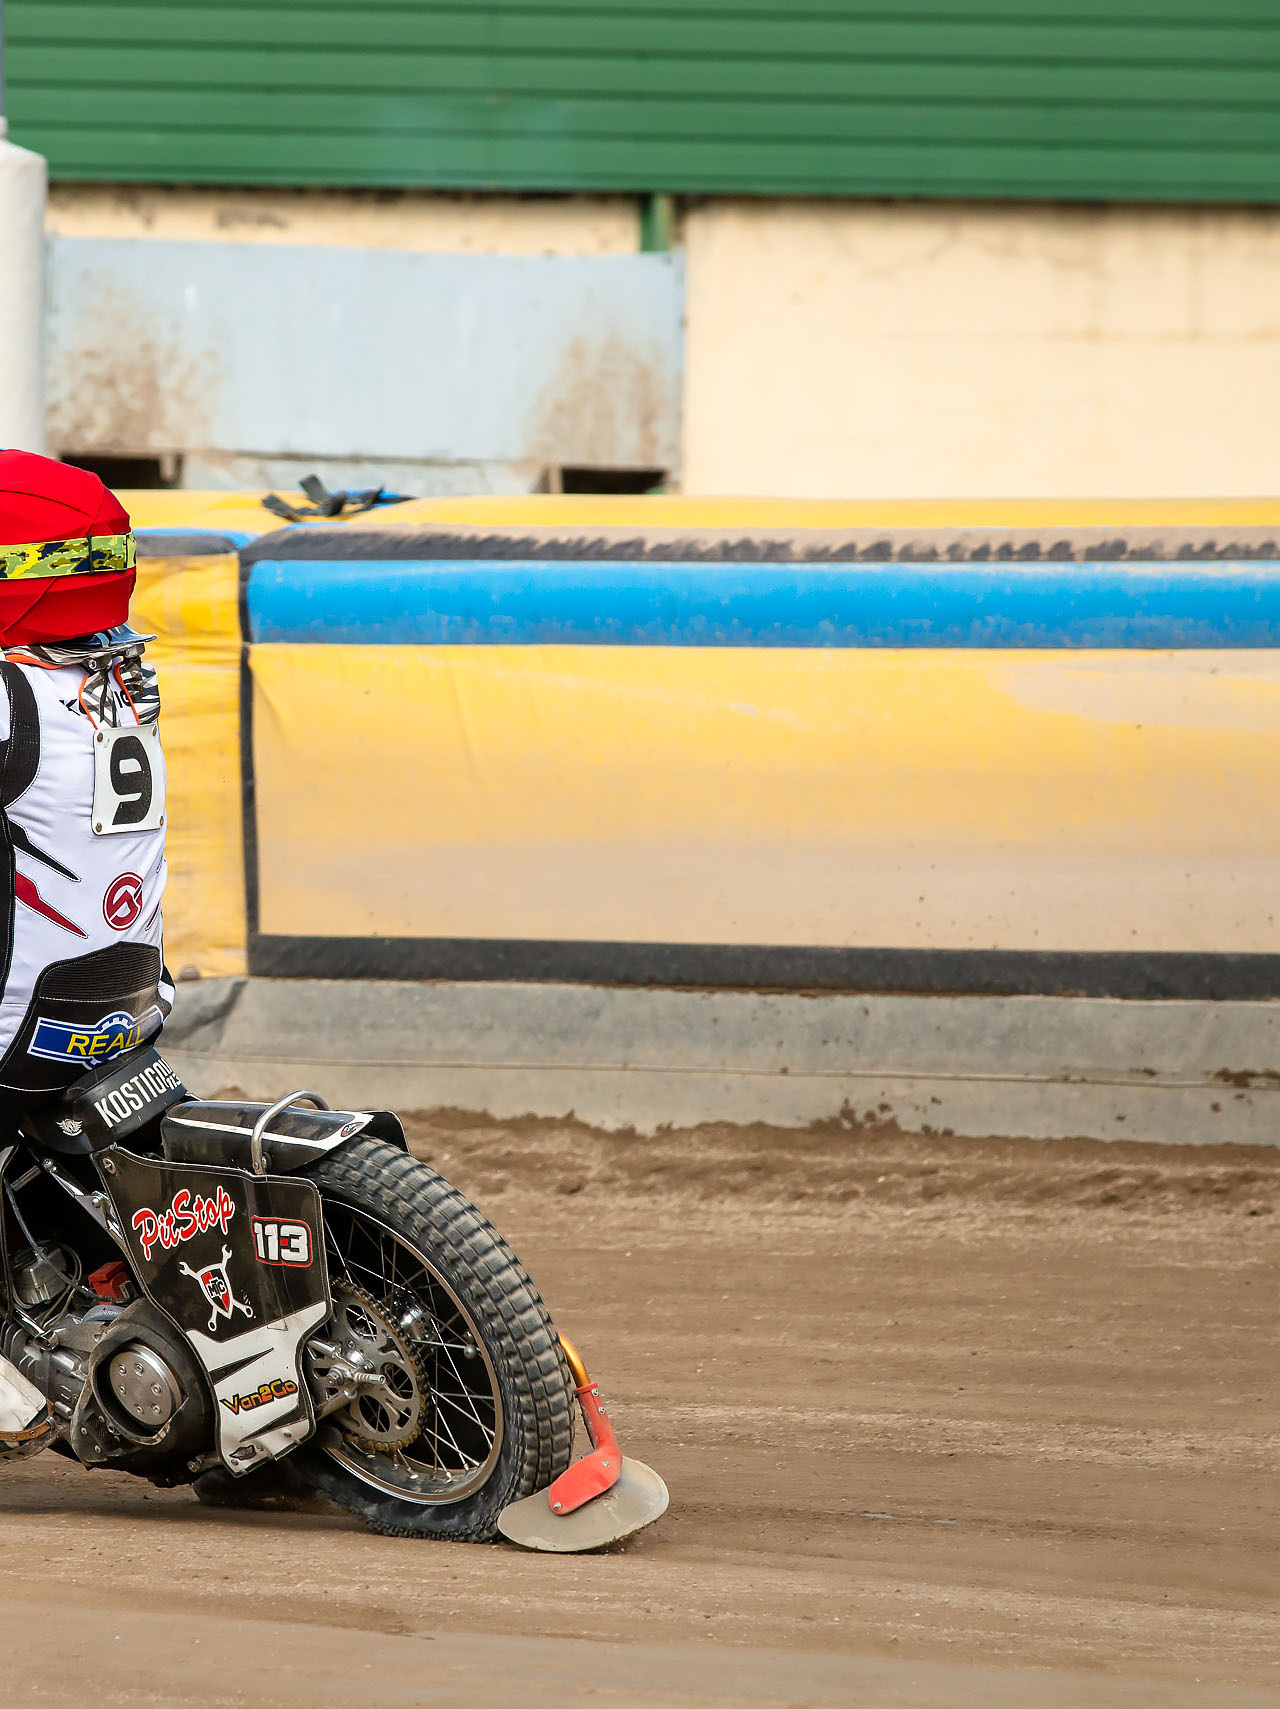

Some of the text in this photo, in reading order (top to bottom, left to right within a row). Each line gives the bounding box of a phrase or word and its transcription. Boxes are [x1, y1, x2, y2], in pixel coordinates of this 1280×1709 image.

[110, 735, 152, 826] 9
[253, 1221, 309, 1262] 113
[219, 1378, 298, 1416] Van2Go
